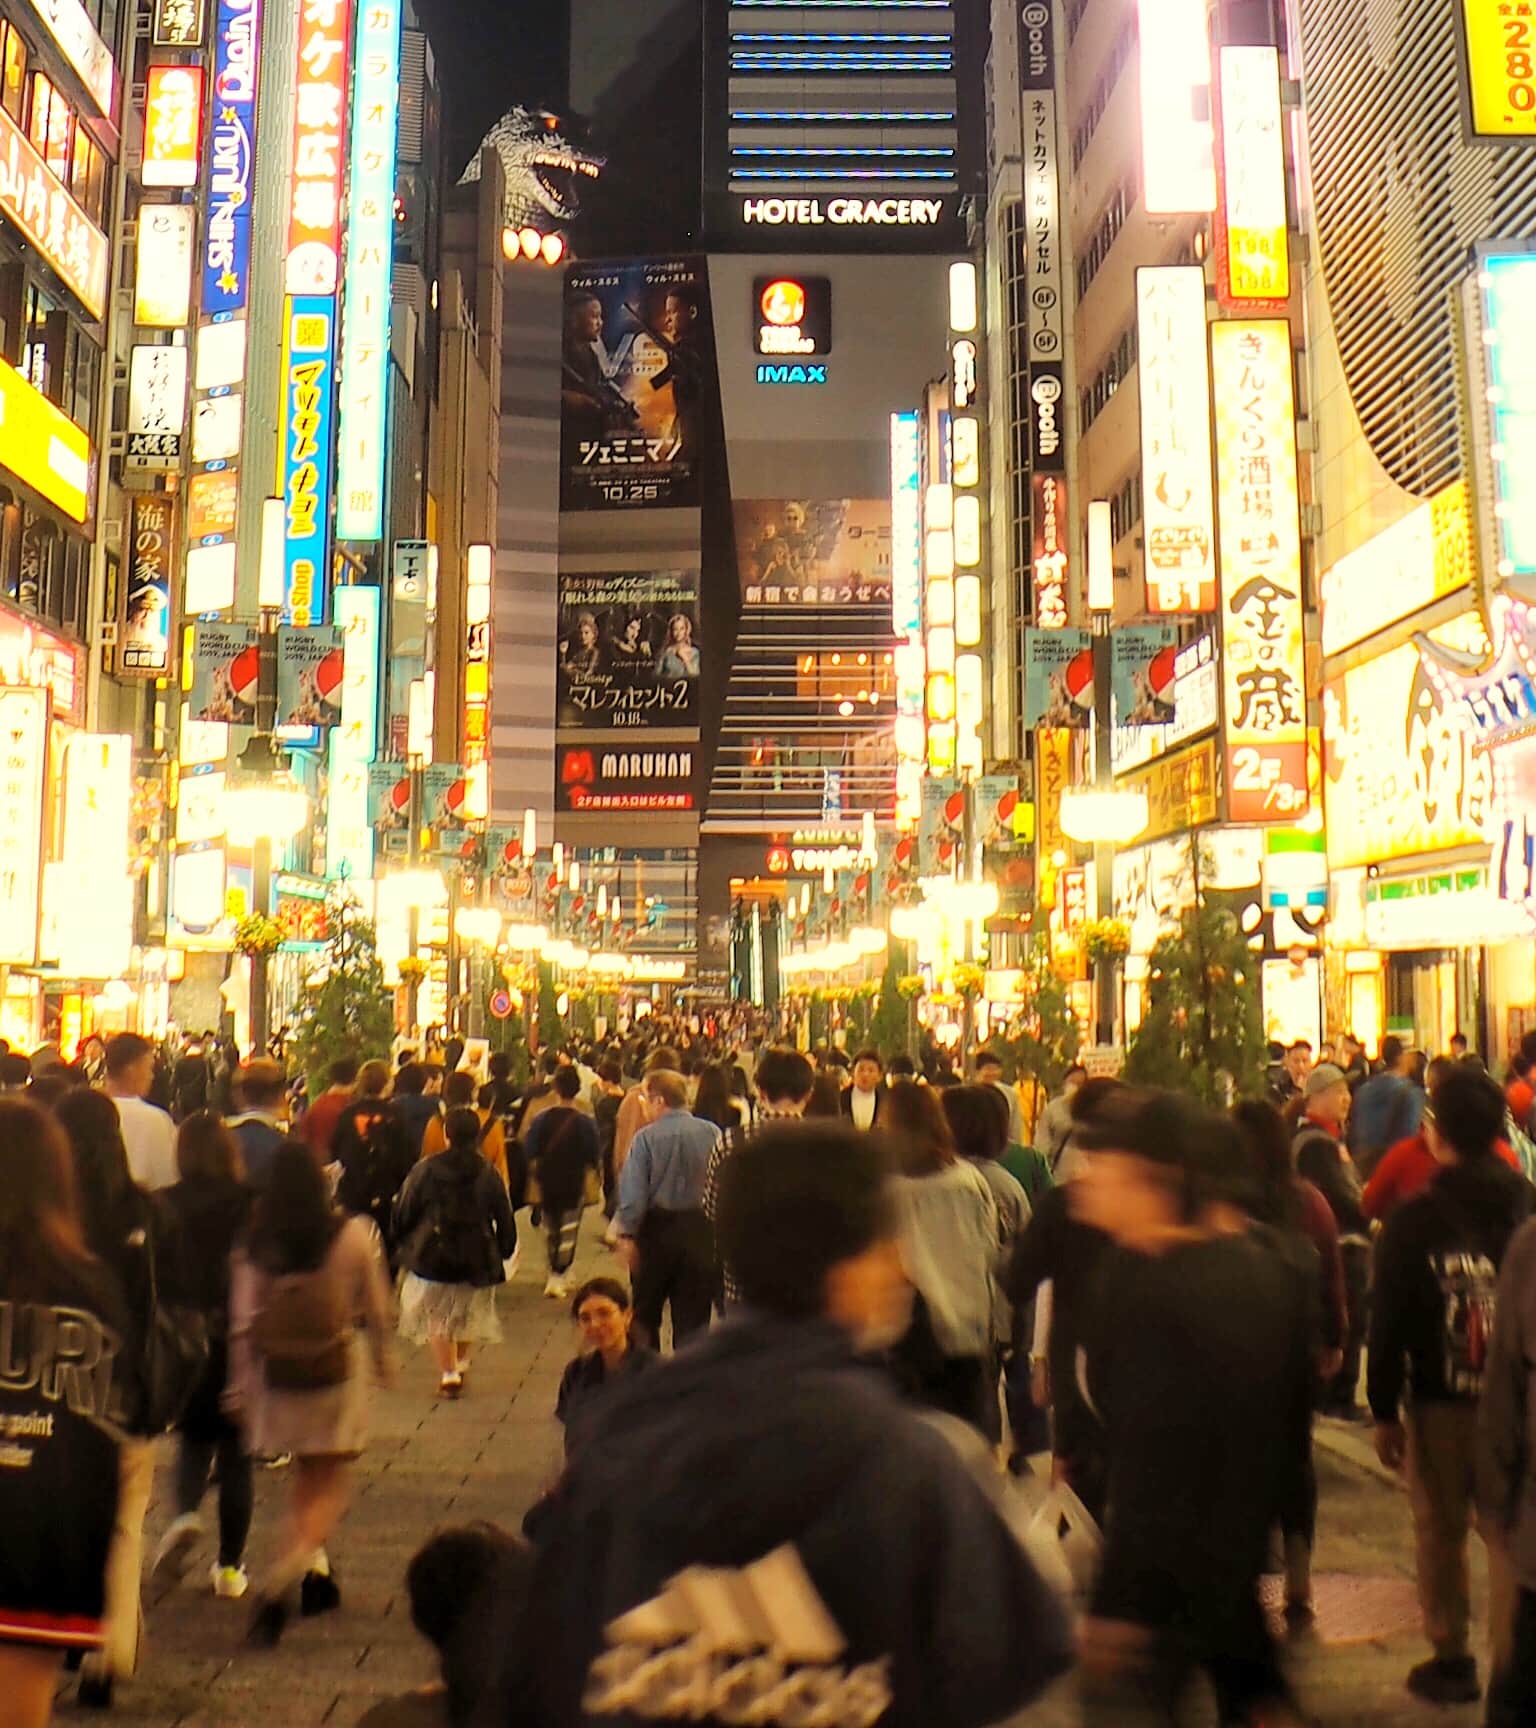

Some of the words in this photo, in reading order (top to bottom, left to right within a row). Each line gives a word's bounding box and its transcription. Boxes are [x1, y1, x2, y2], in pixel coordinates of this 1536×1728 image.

[1021, 2, 1051, 76] Booth
[207, 126, 248, 271] SHINJUKU
[743, 199, 824, 224] HOTEL
[827, 199, 943, 225] GRACERY
[756, 364, 827, 384] IMAX
[128, 433, 179, 457] 大阪家
[288, 362, 327, 540] マツモトキヨシ
[1030, 373, 1062, 455] Booth
[134, 504, 165, 583] 海の家
[1230, 575, 1304, 731] 金の蔵
[601, 753, 692, 779] MARUHAN
[4, 1412, 55, 1439] point
